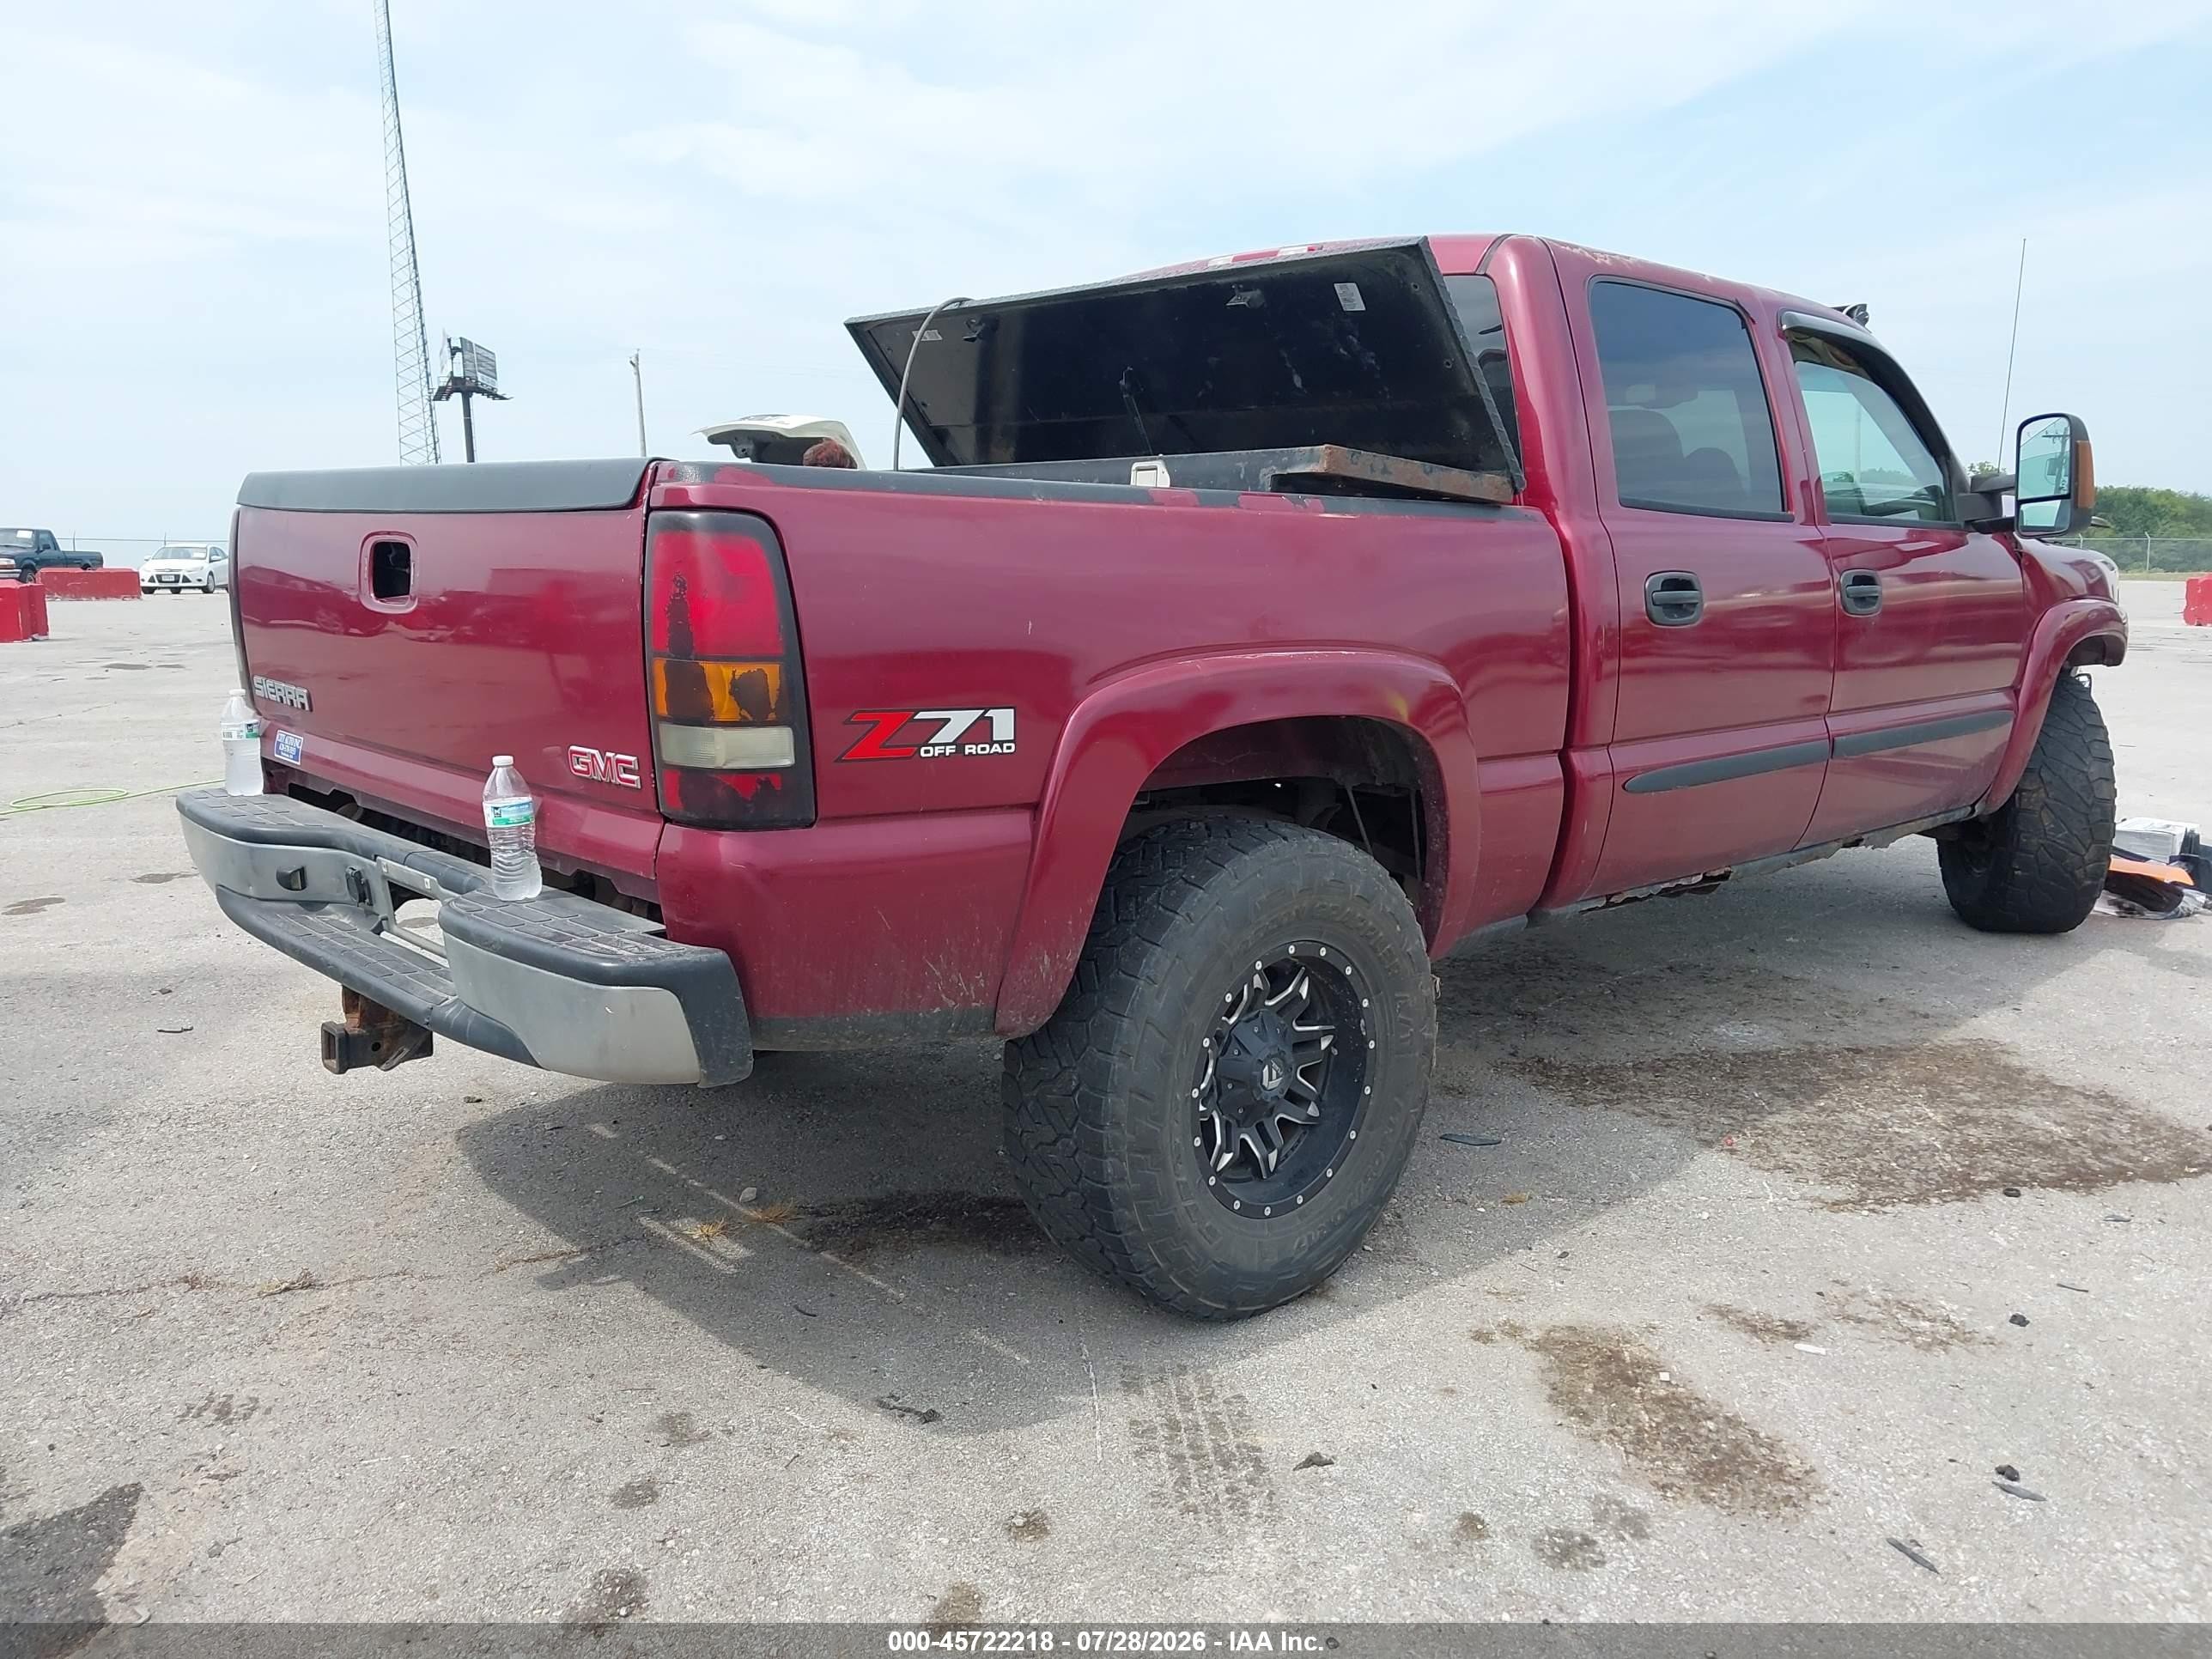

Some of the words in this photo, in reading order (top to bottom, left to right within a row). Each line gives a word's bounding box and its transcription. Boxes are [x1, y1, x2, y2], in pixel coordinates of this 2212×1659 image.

[253, 675, 310, 711] SIERRA
[841, 708, 1015, 760] Z71
[920, 744, 957, 757] OFF
[964, 742, 1016, 756] ROAD
[568, 744, 641, 789] GMC
